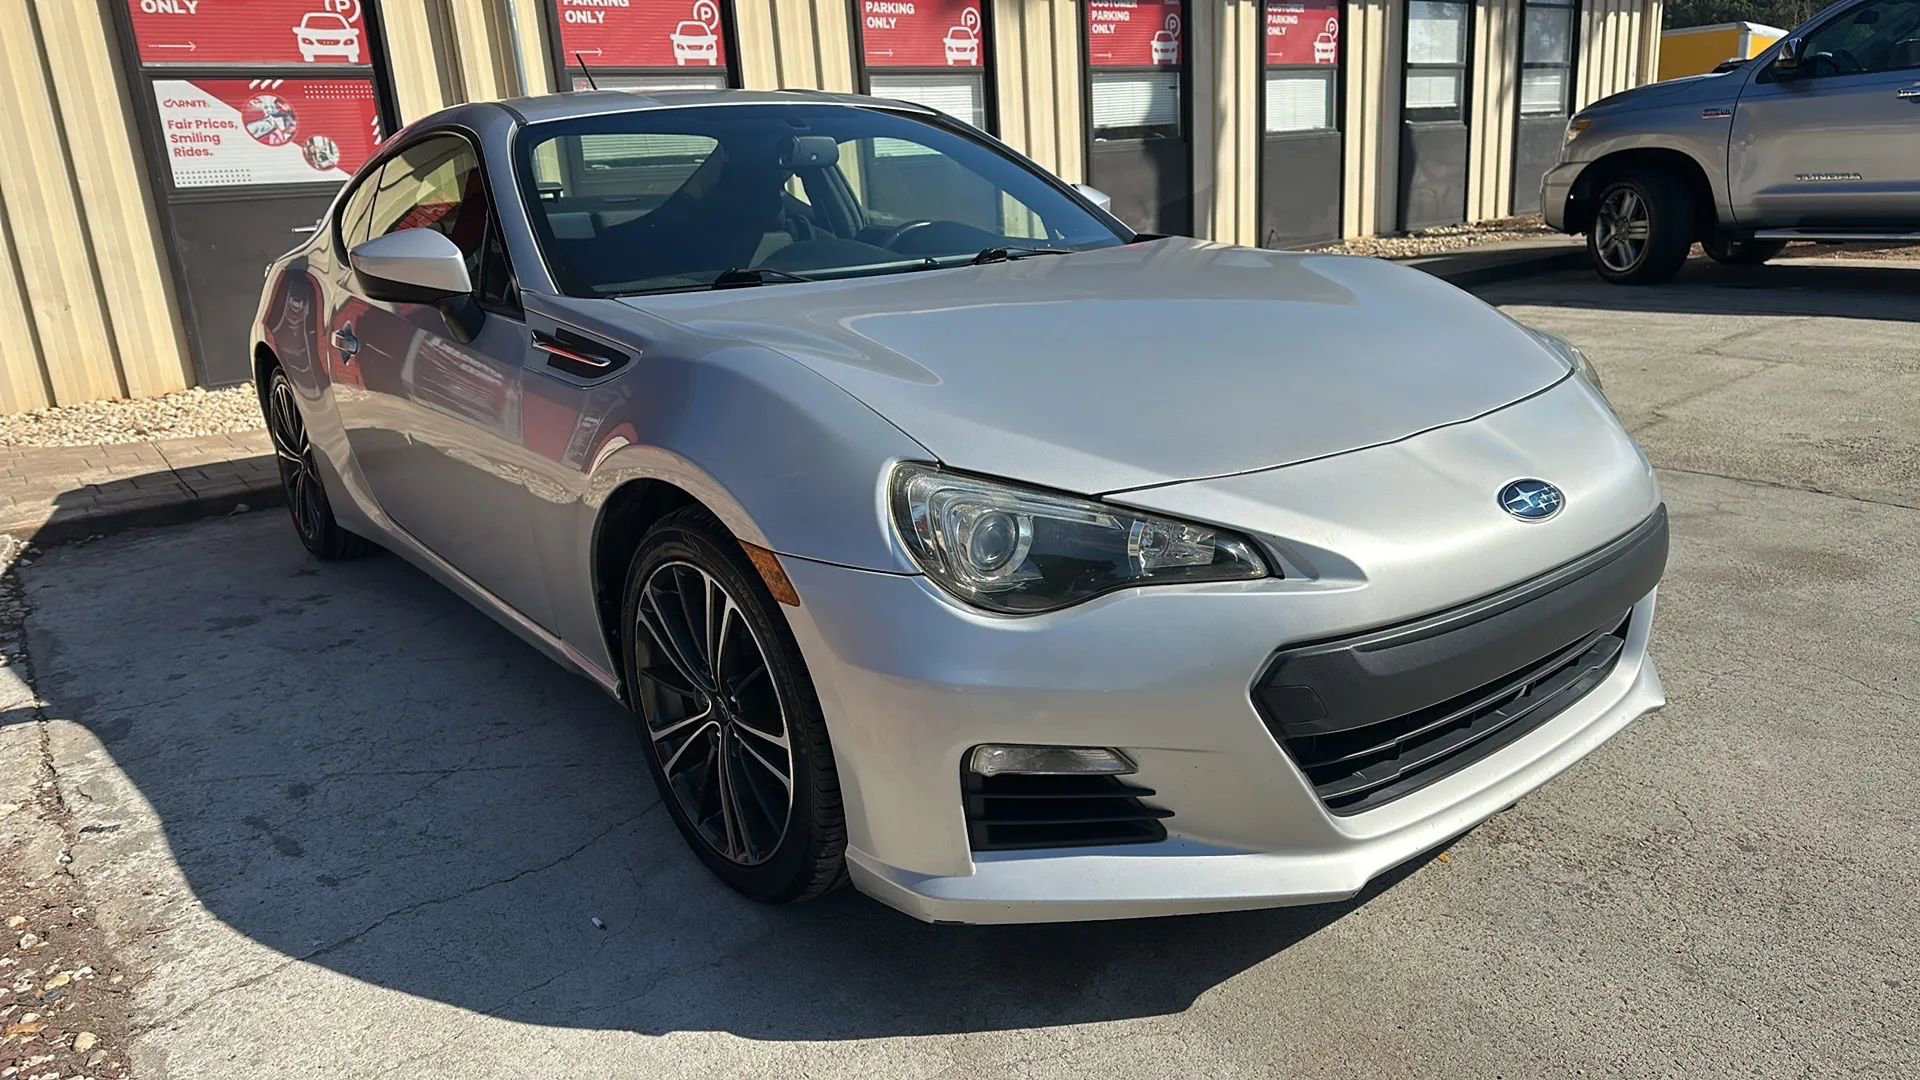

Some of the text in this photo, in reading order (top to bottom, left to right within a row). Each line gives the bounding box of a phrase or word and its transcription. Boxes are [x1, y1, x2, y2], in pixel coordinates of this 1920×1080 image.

[140, 0, 198, 14] ONLY
[865, 1, 915, 14] PARKING
[565, 10, 605, 23] ONLY
[1091, 11, 1130, 21] PARKING
[866, 17, 897, 28] ONLY
[1092, 24, 1115, 33] ONLY
[1267, 27, 1287, 35] ONLY
[167, 117, 238, 130] Fair Prices,
[170, 131, 221, 146] Smiling
[173, 146, 214, 158] Rides.
